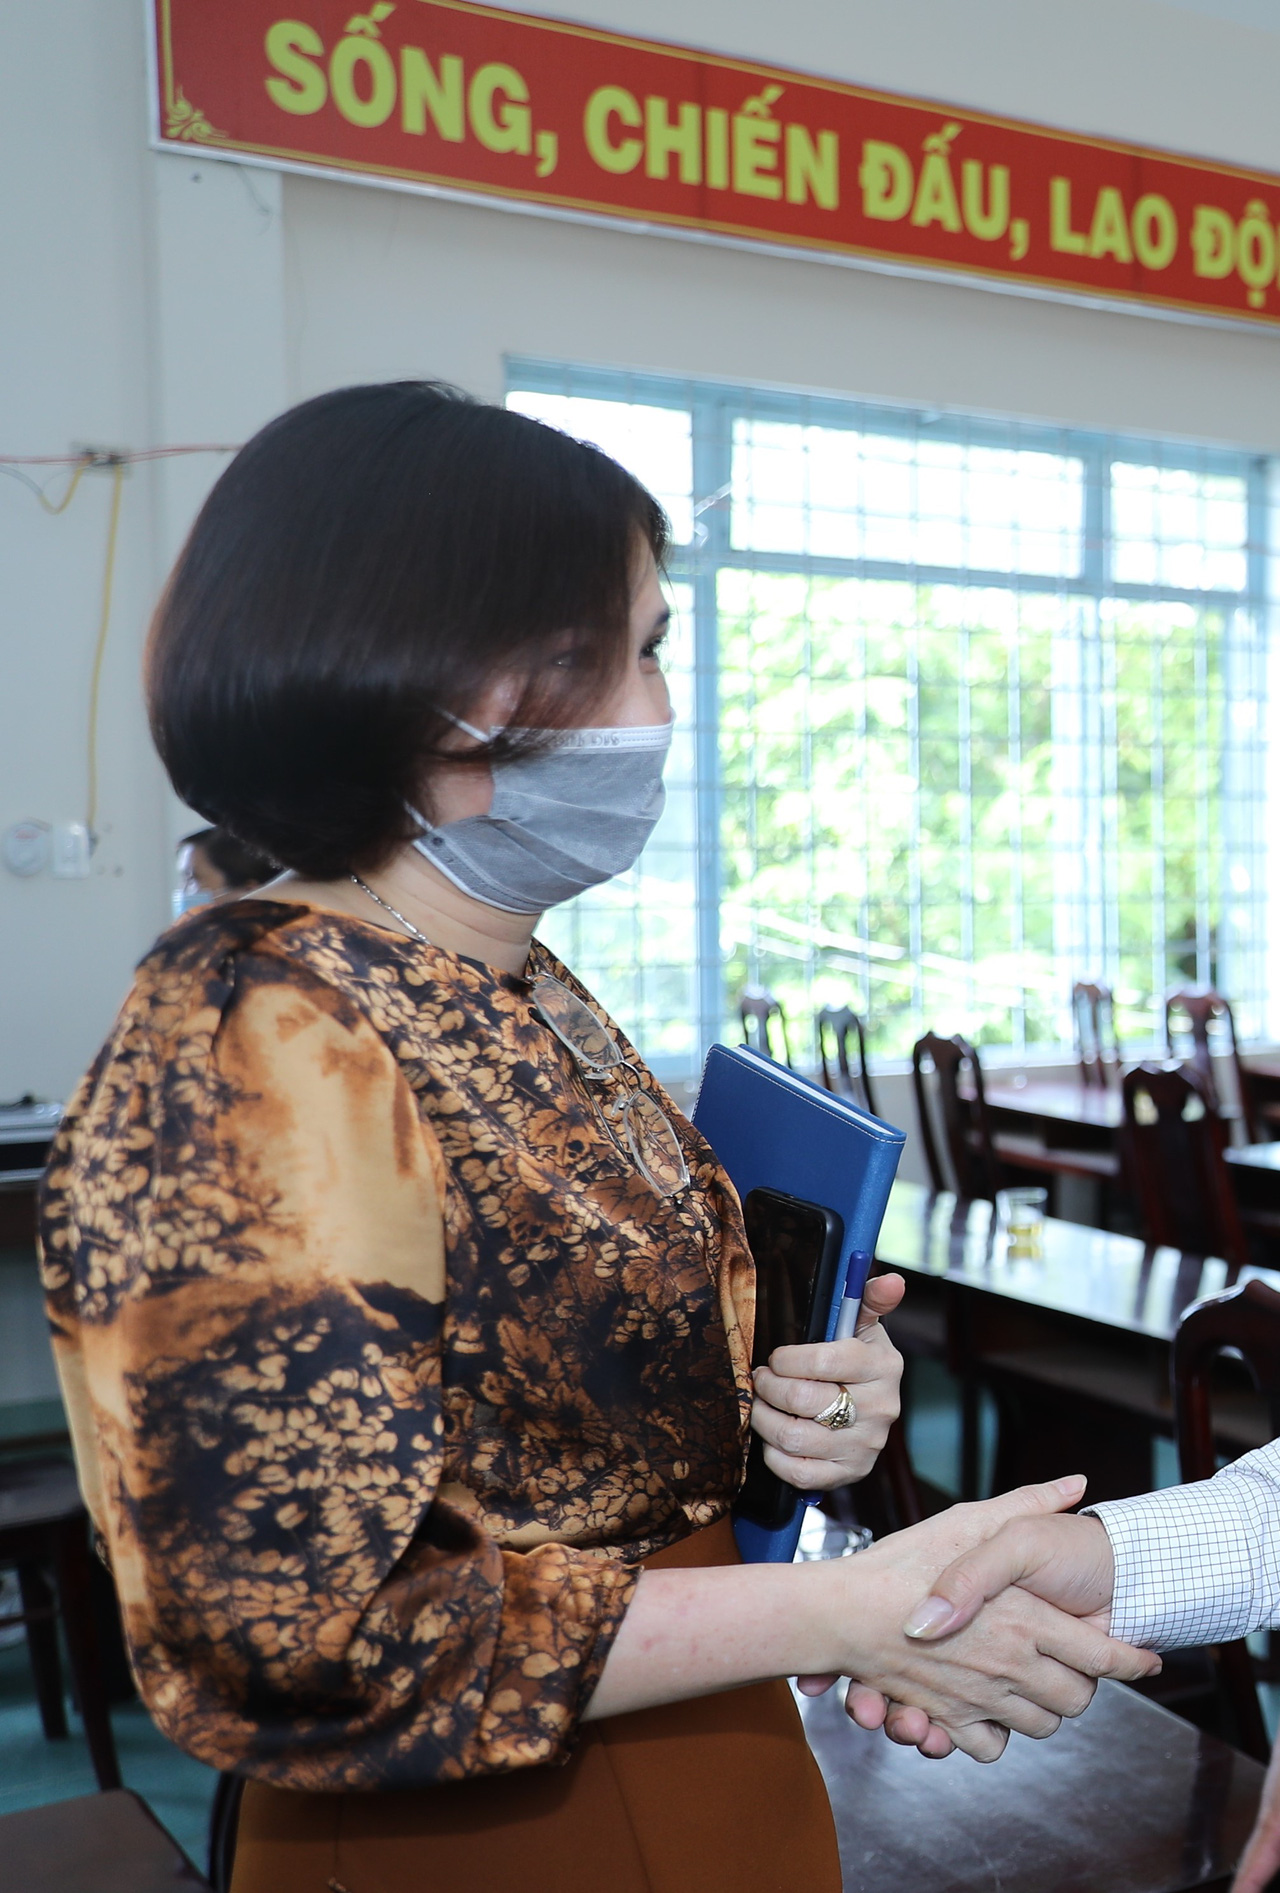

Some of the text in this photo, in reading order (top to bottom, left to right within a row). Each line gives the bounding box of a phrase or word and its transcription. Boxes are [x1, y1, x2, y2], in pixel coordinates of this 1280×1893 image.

[265, 2, 557, 177] SỐNG,
[584, 85, 839, 211] CHIẾN
[859, 123, 1029, 260] ĐẤU,
[1050, 176, 1178, 270] LAO
